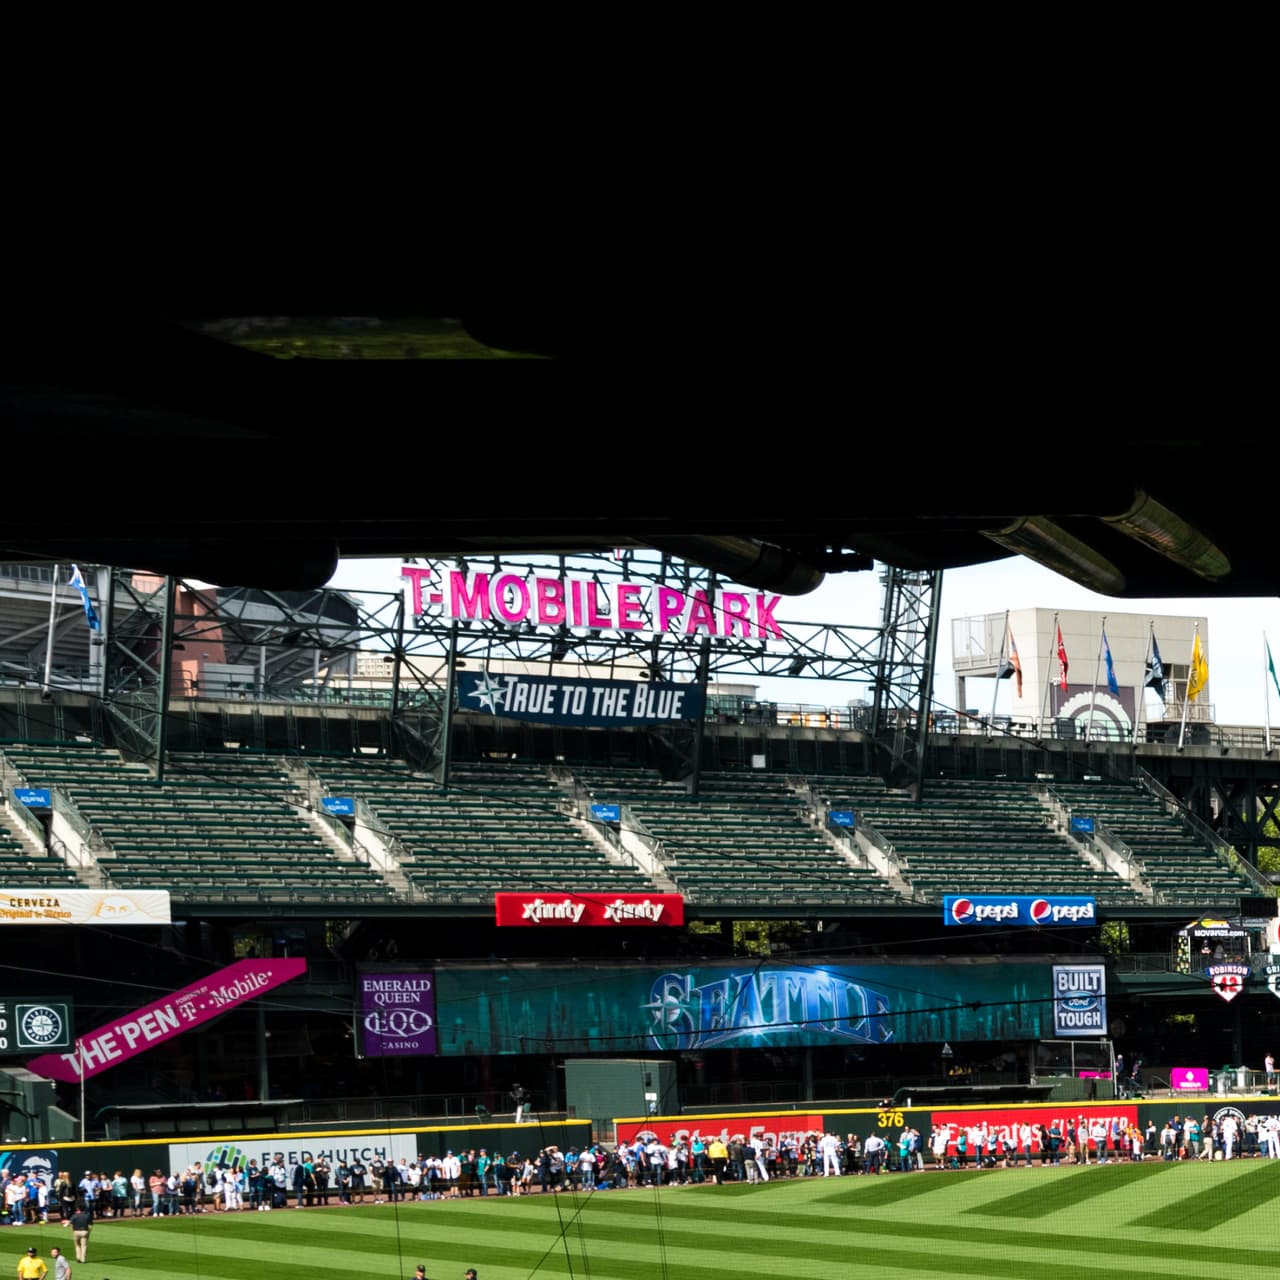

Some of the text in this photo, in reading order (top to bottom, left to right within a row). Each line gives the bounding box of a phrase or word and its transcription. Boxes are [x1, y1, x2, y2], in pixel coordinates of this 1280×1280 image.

[401, 566, 785, 640] T-MOBILE PARK
[503, 676, 685, 720] TRUE TO THE BLUE
[9, 898, 60, 907] CERVEZA
[522, 899, 664, 923] xfinity xfinity
[975, 902, 1094, 922] pepsi pepsi
[1209, 965, 1248, 975] ROBINSON
[363, 980, 431, 992] EMERALD
[1058, 972, 1100, 991] BUILT
[1221, 976, 1238, 993] 42
[374, 992, 420, 1006] QUEEN
[1059, 1012, 1100, 1027] TOUGH
[61, 1030, 122, 1076] THE
[877, 1112, 904, 1128] 376
[321, 1147, 386, 1163] HUTCH
